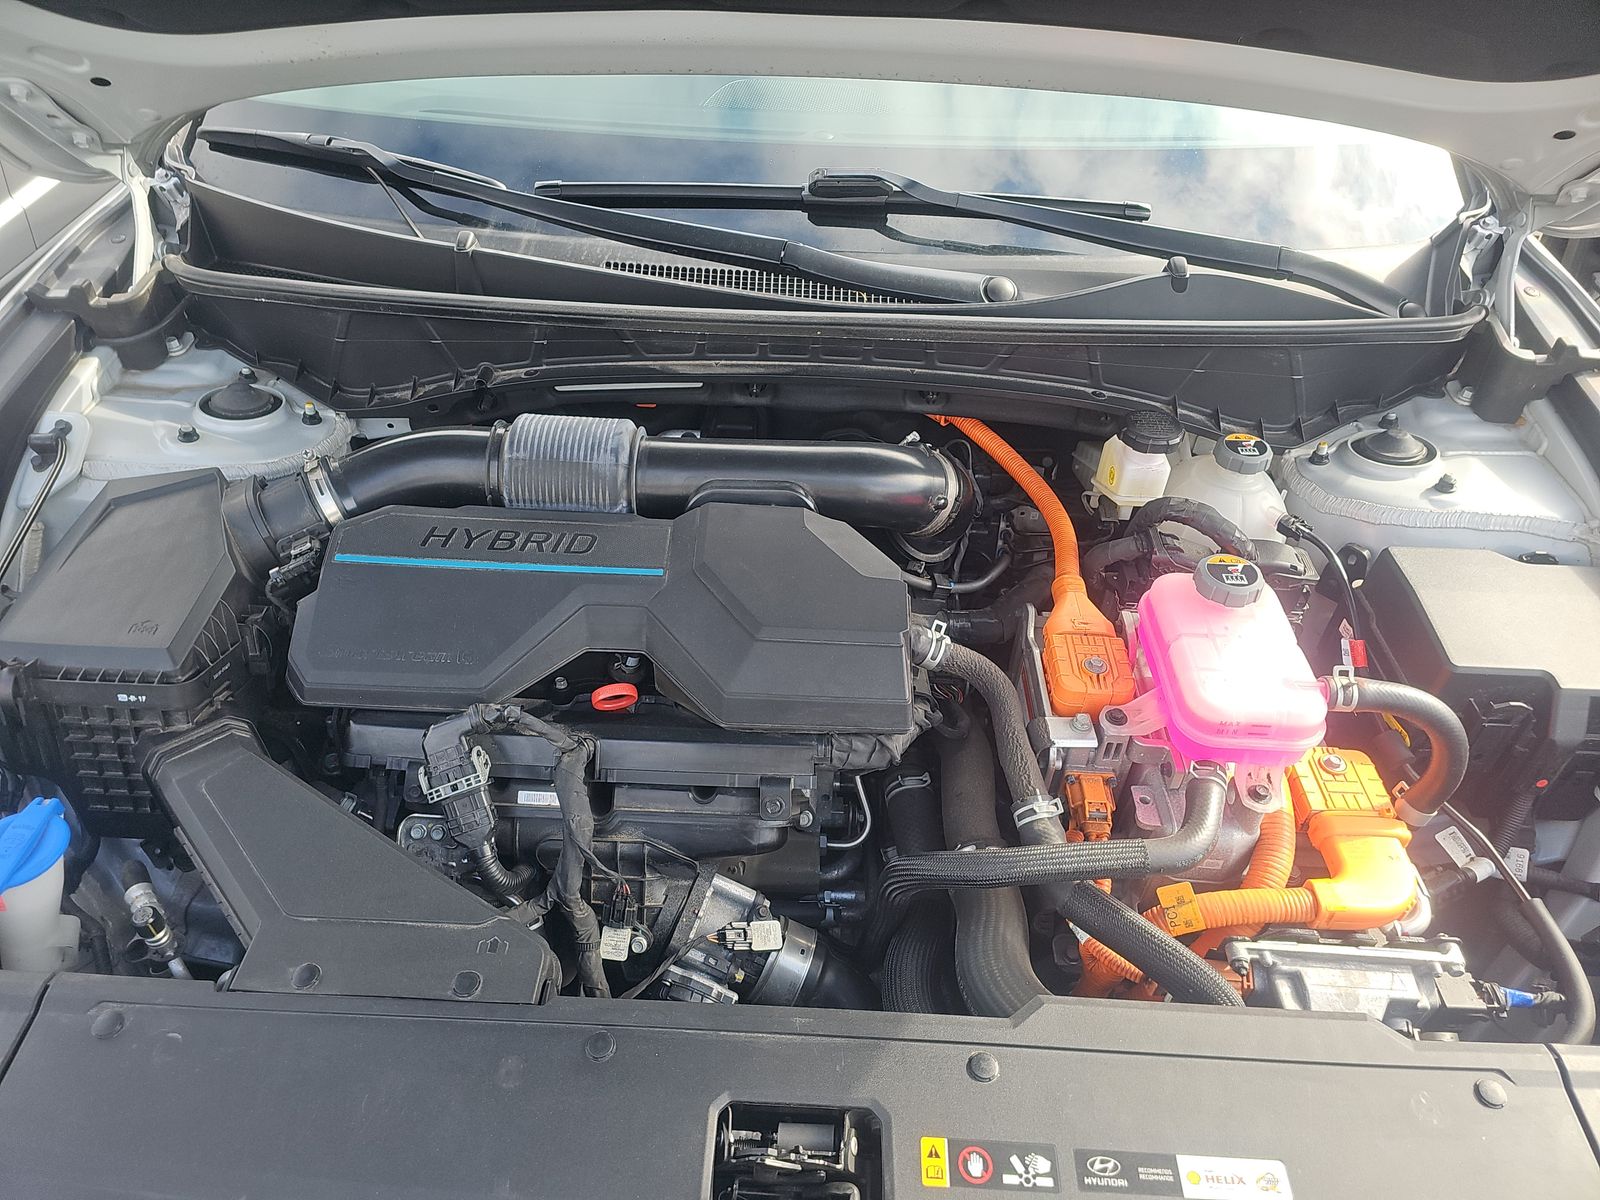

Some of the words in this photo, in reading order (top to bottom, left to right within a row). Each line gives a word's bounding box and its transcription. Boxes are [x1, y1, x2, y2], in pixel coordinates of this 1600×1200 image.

[420, 526, 598, 554] HYBRID
[1083, 1176, 1129, 1188] HYUNDAI
[1204, 1173, 1247, 1185] HELIX
